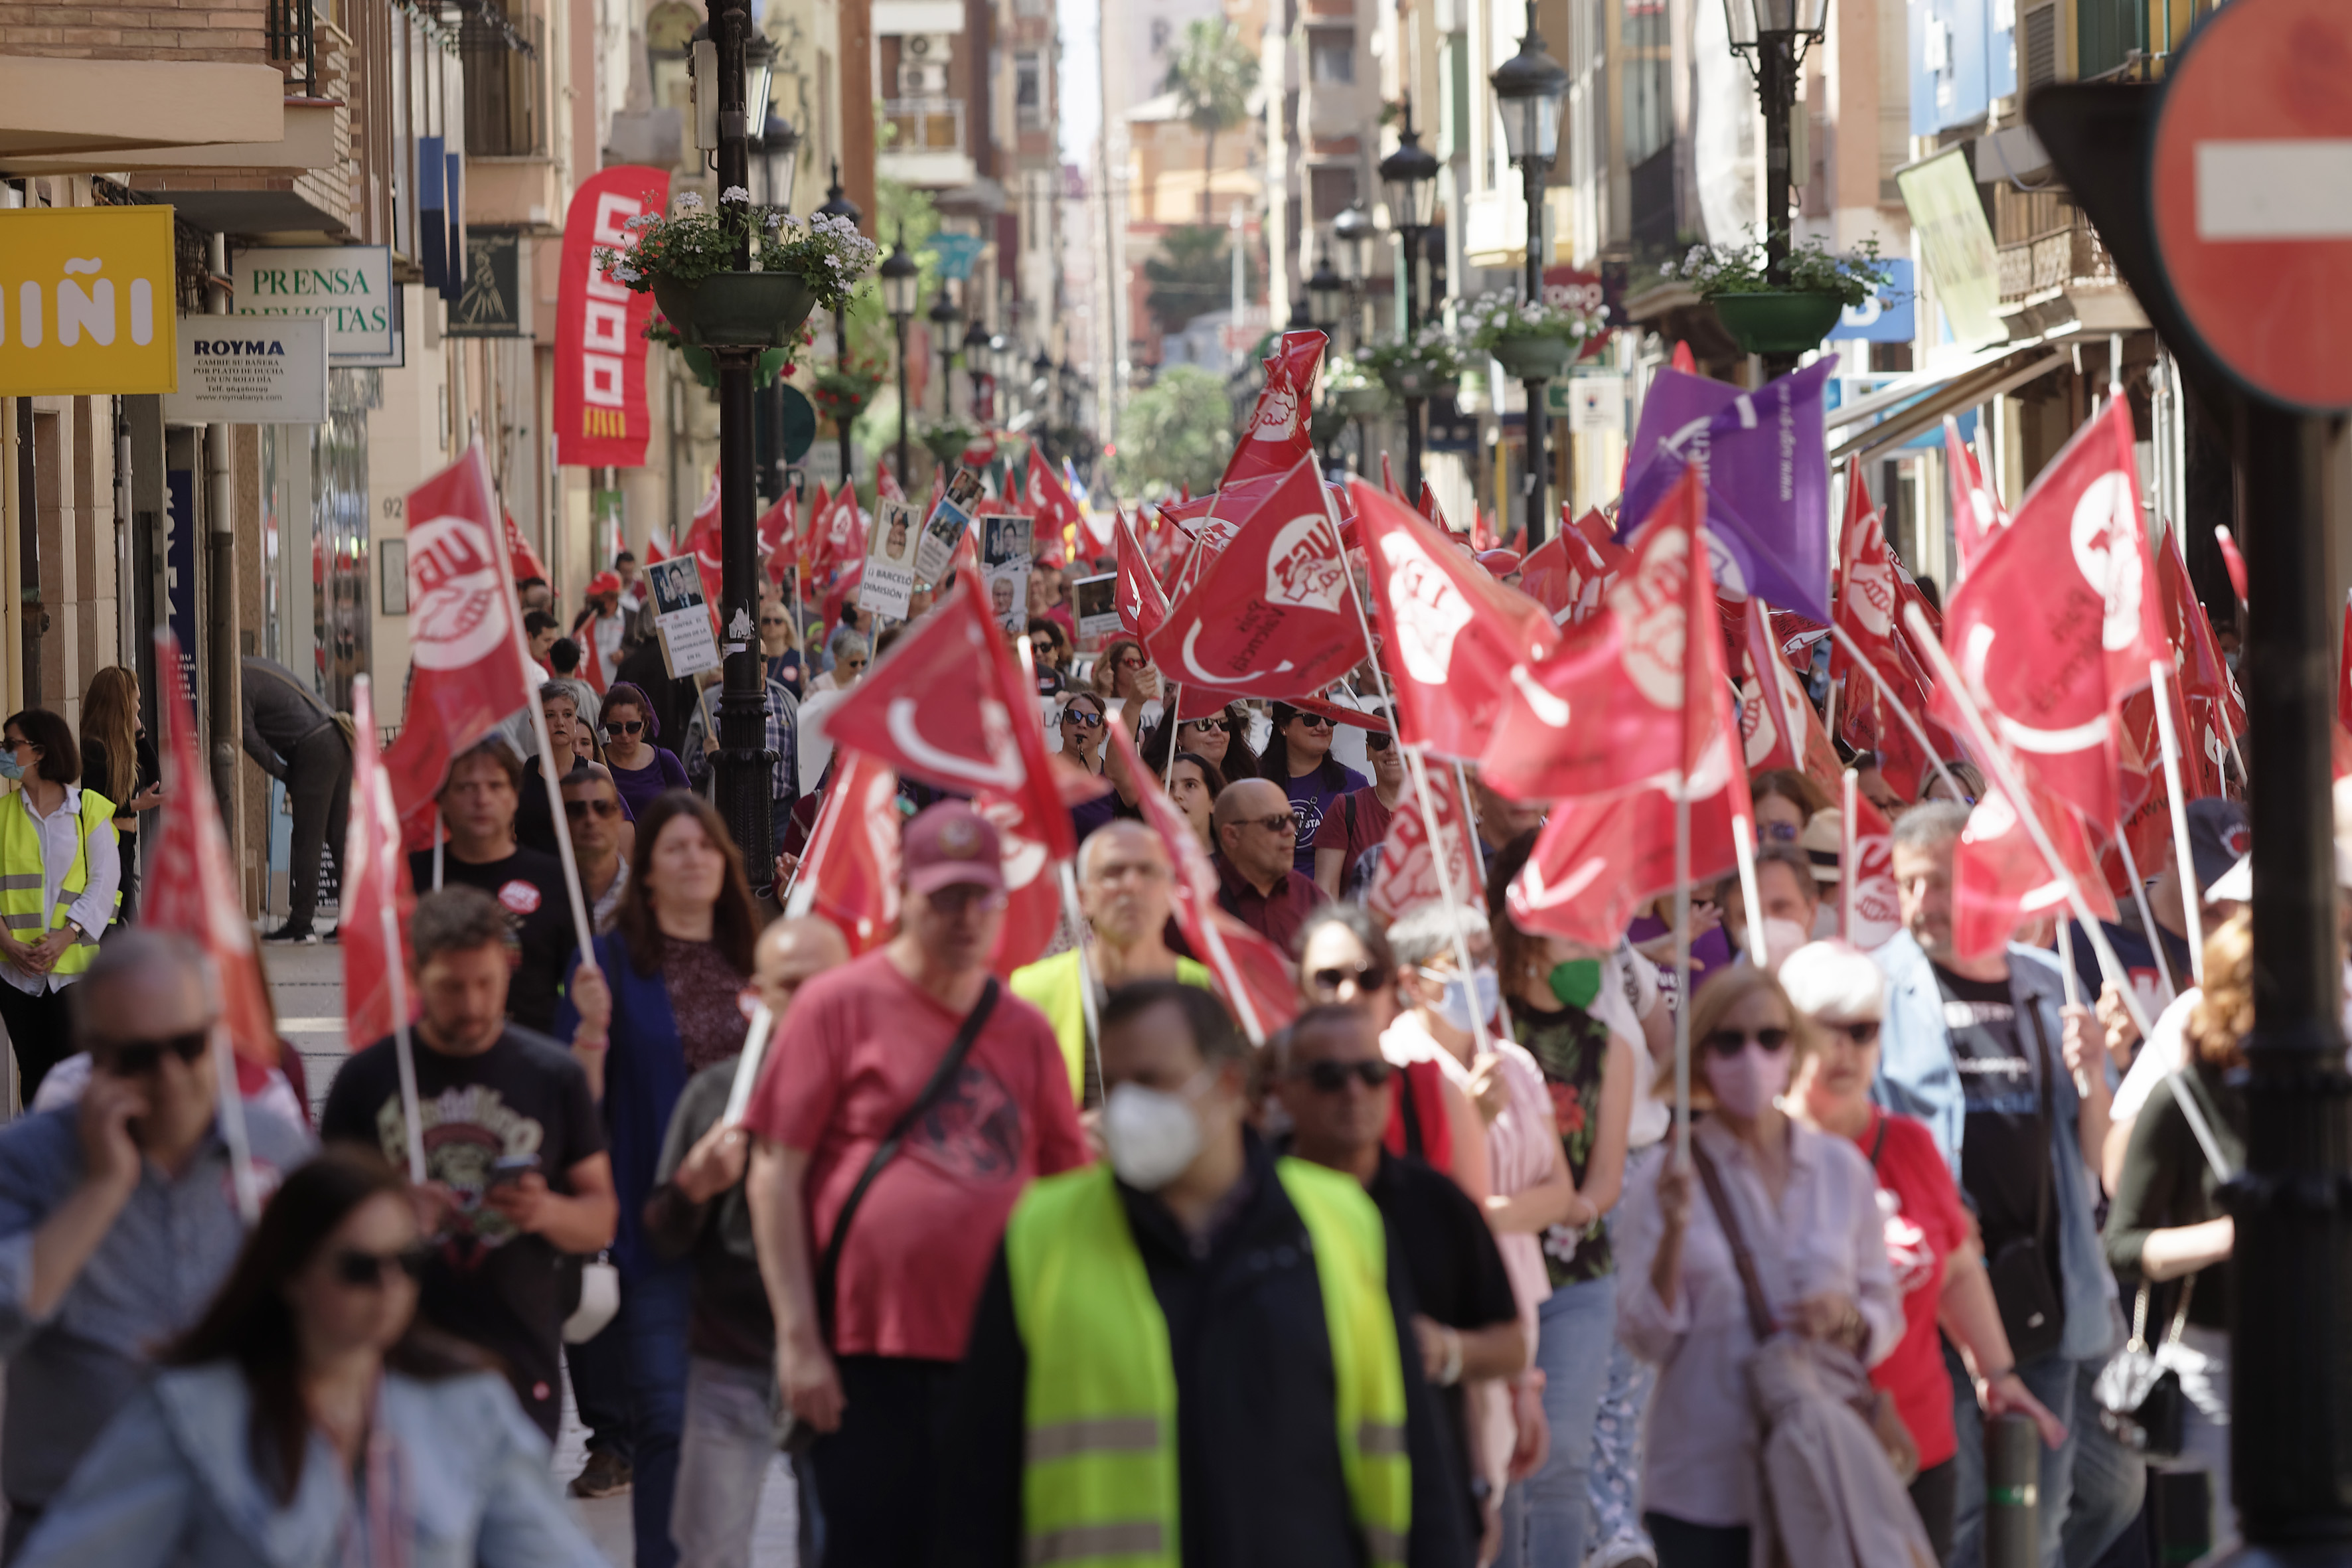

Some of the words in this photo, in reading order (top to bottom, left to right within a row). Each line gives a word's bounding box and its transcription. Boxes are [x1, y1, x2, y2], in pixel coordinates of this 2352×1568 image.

[253, 268, 370, 295] PRENSA
[0, 257, 153, 349] IÑI
[194, 340, 285, 356] ROYMA
[383, 497, 402, 519] 92
